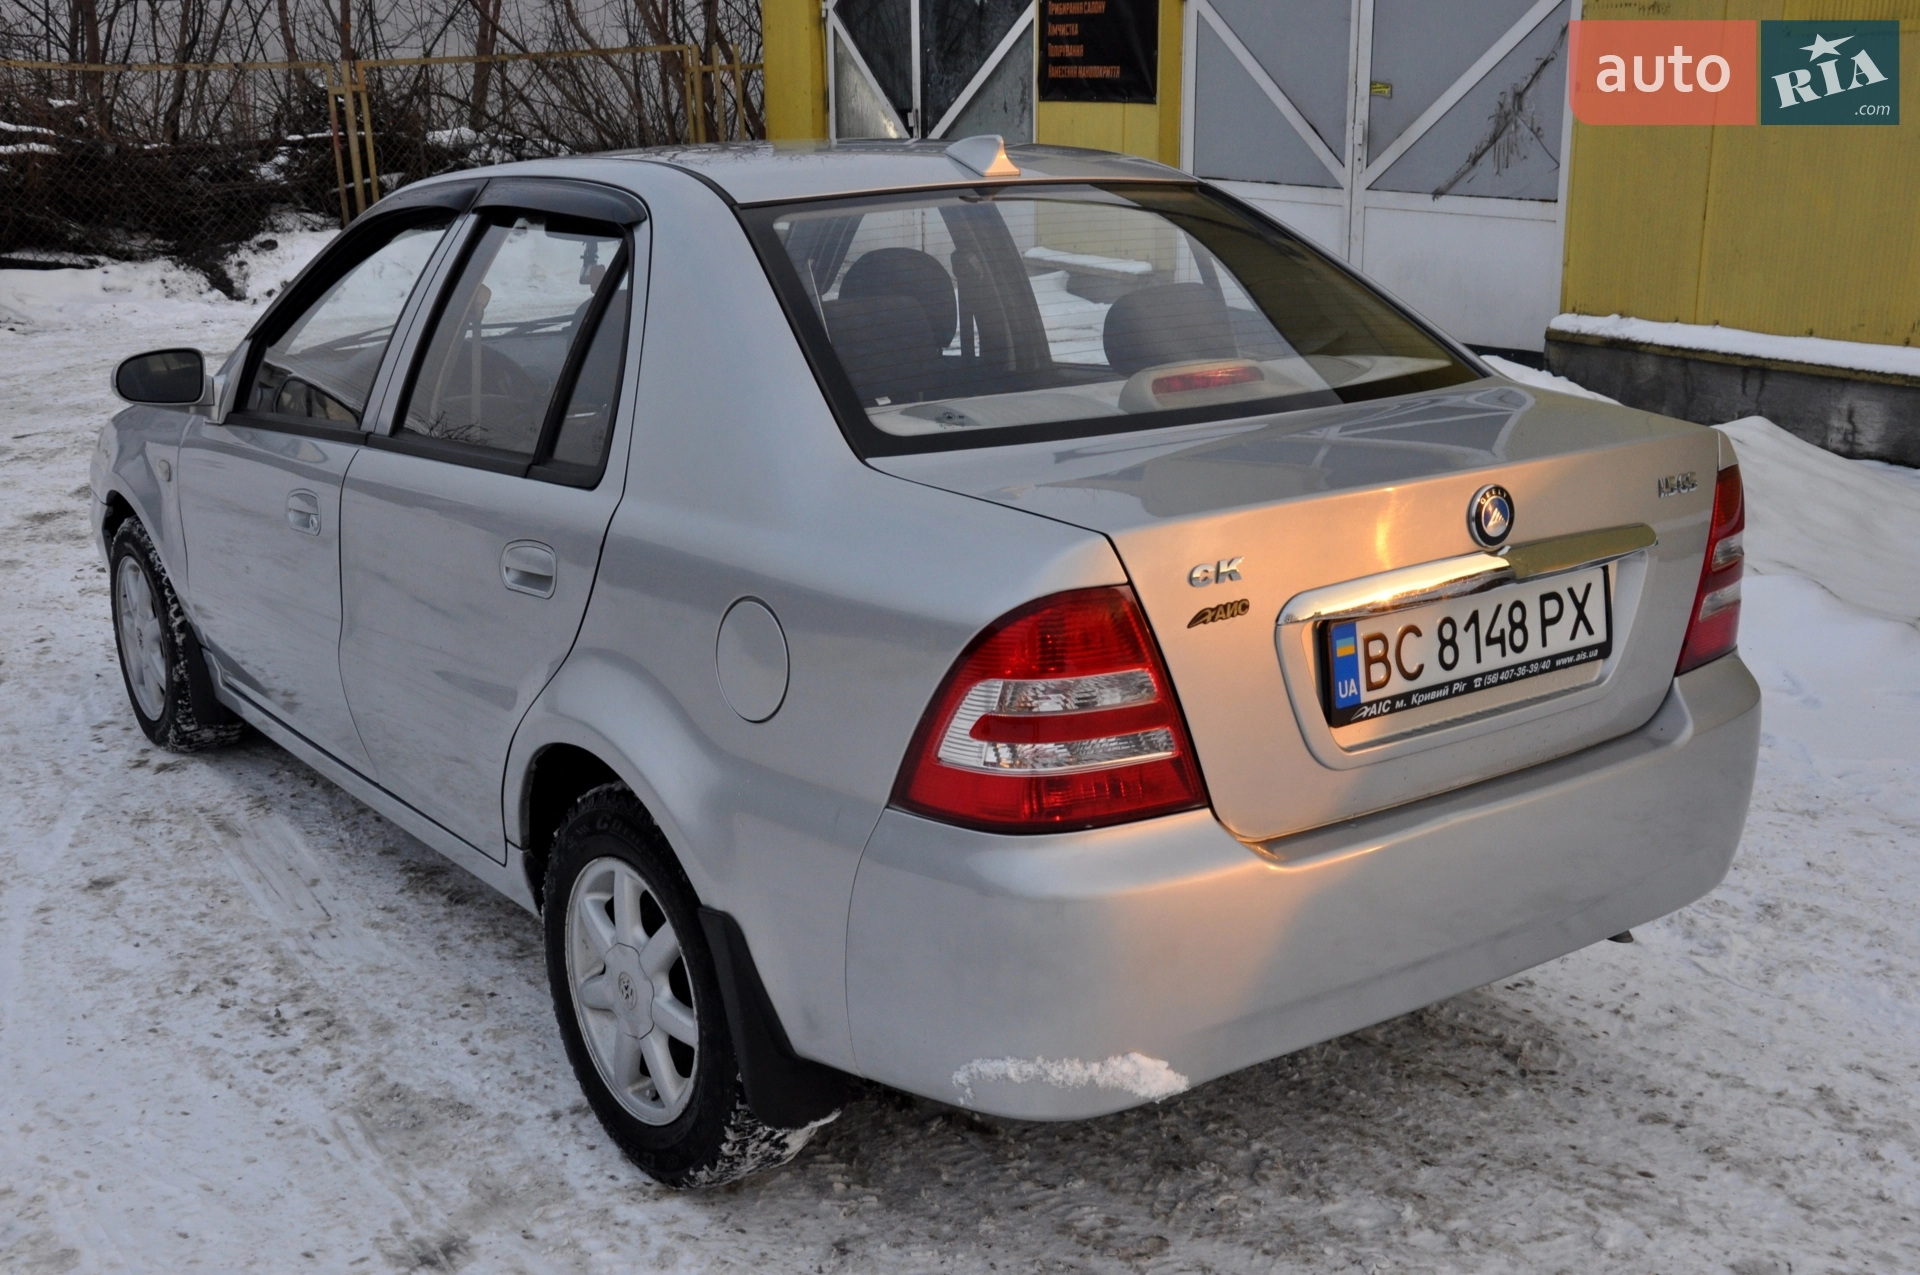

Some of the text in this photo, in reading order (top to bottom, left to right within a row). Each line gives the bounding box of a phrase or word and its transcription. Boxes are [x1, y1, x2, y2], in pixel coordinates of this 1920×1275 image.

[1187, 556, 1245, 588] CK
[1362, 582, 1595, 692] BC 8148 PX
[1338, 678, 1358, 699] UA
[1411, 684, 1450, 707] Кривий
[1555, 647, 1599, 667] www.ais.ua
